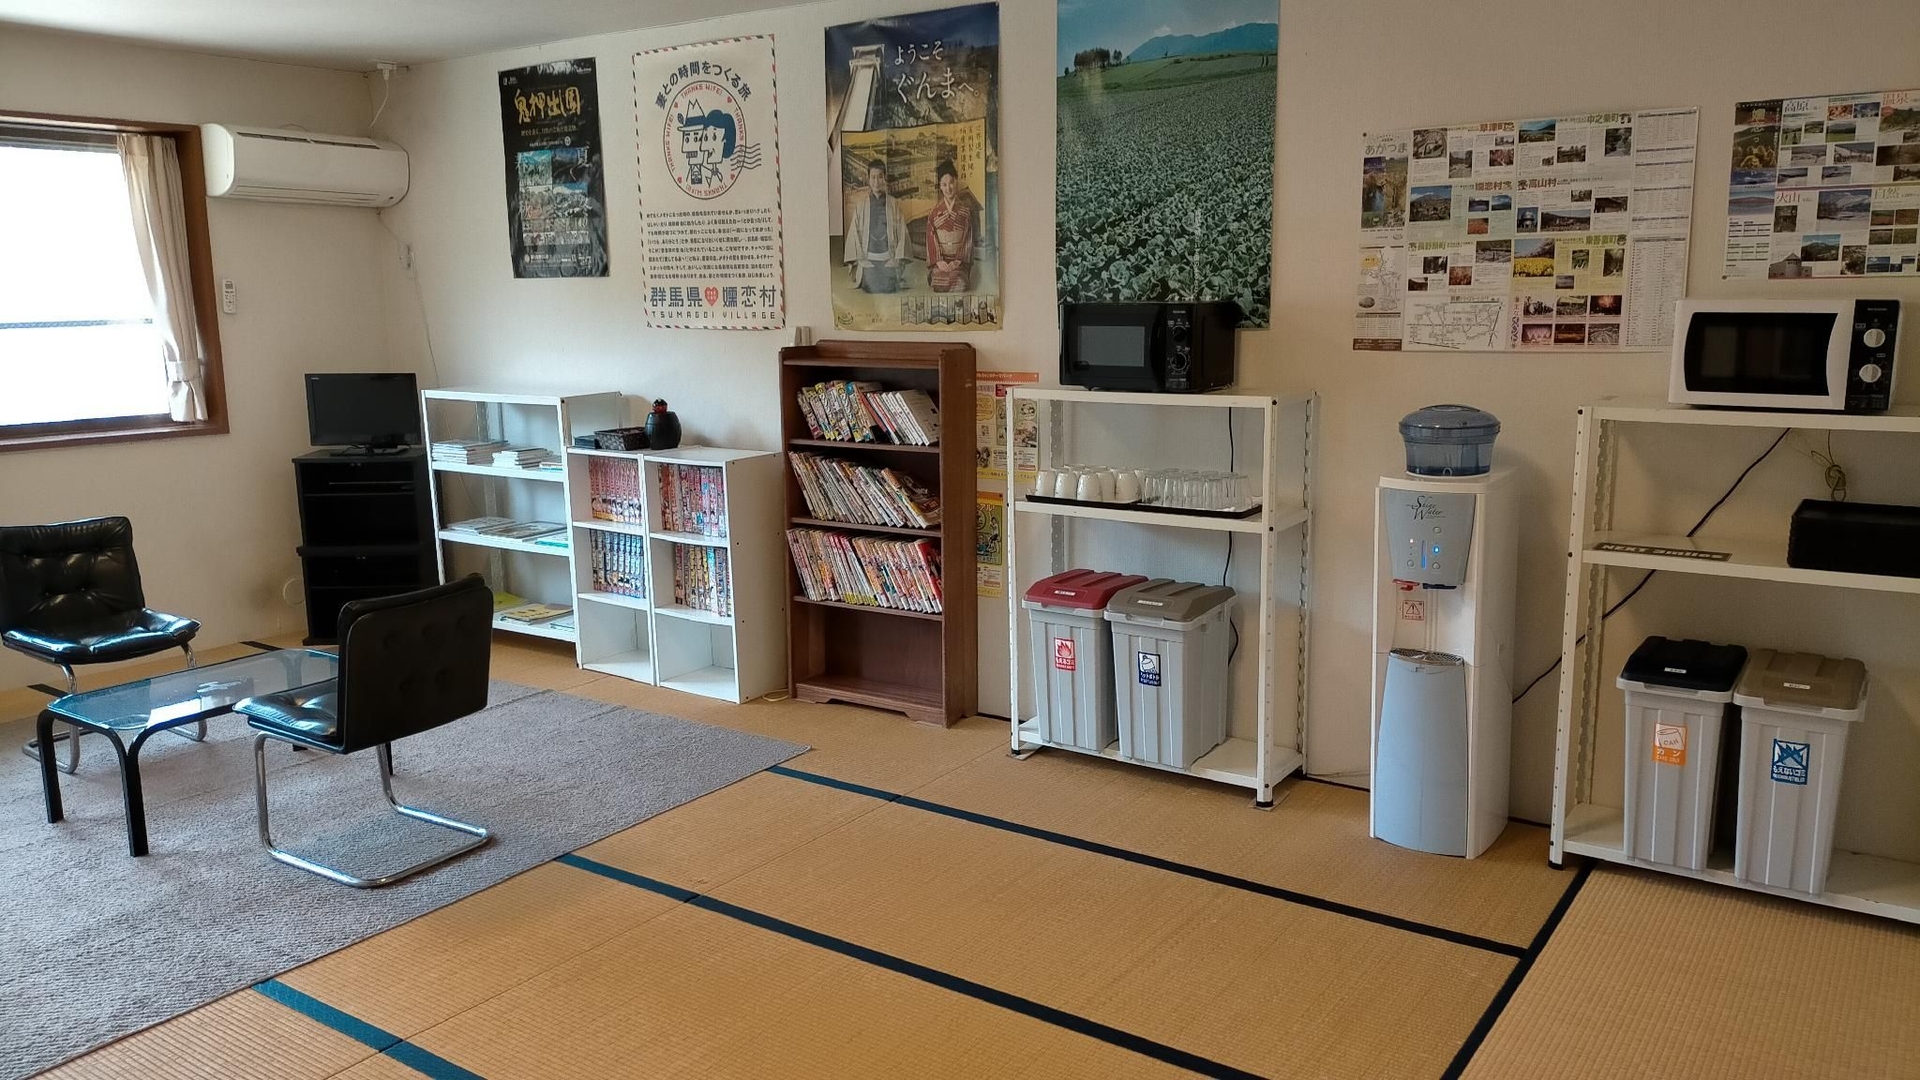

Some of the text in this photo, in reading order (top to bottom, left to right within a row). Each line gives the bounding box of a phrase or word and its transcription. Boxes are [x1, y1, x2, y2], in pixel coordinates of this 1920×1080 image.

[894, 40, 944, 65] ようこそ
[655, 60, 753, 110] 妻との時間をつくる旅
[897, 67, 979, 104] ぐんまへ。
[1882, 92, 1909, 106] 温泉
[1784, 100, 1809, 113] 高原
[1365, 142, 1408, 156] あがつま
[1528, 175, 1557, 187] 高山村
[1776, 191, 1801, 204] 火山
[1873, 187, 1902, 200] 自然
[650, 285, 777, 308] 群馬県 嬬恋村
[651, 311, 776, 320] TSUMAGOI VILLAGE
[1601, 544, 1648, 553] NEXT
[1663, 738, 1679, 746] CAN
